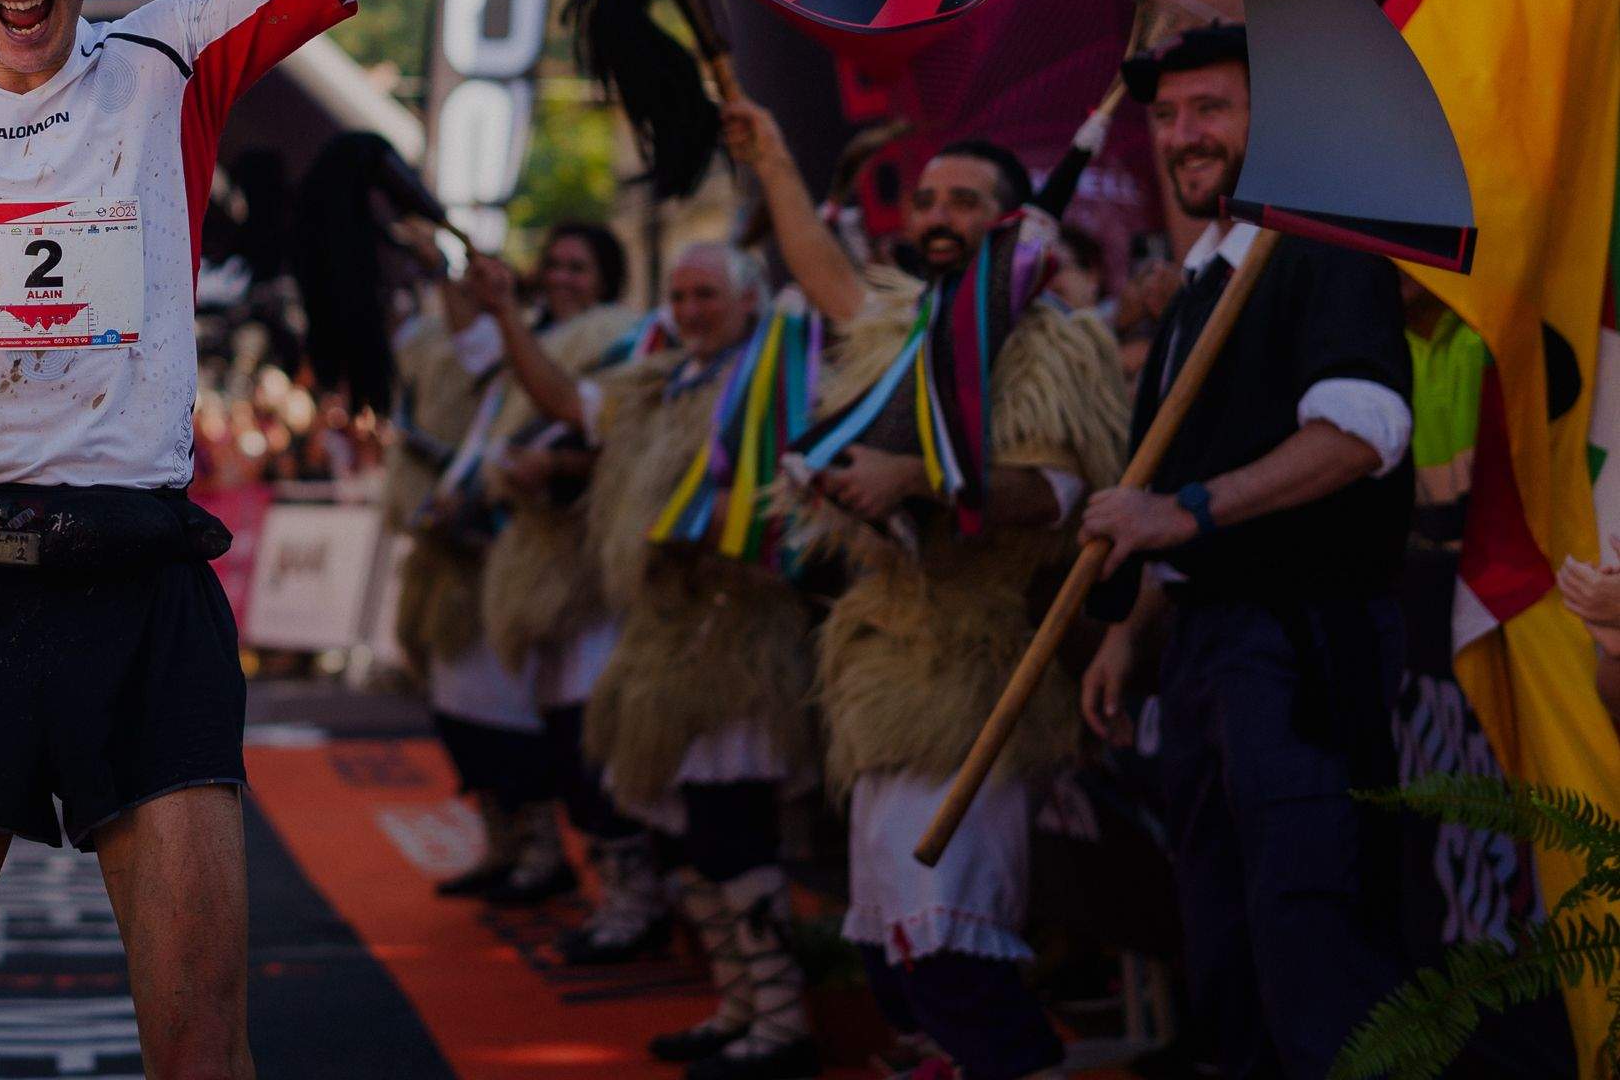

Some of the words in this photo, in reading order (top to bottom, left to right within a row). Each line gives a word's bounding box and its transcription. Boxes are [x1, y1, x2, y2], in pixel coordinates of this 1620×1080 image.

[109, 206, 137, 219] 2023
[24, 239, 63, 288] 2
[27, 290, 62, 299] ALAIN
[106, 333, 117, 343] 112
[16, 547, 28, 561] 2
